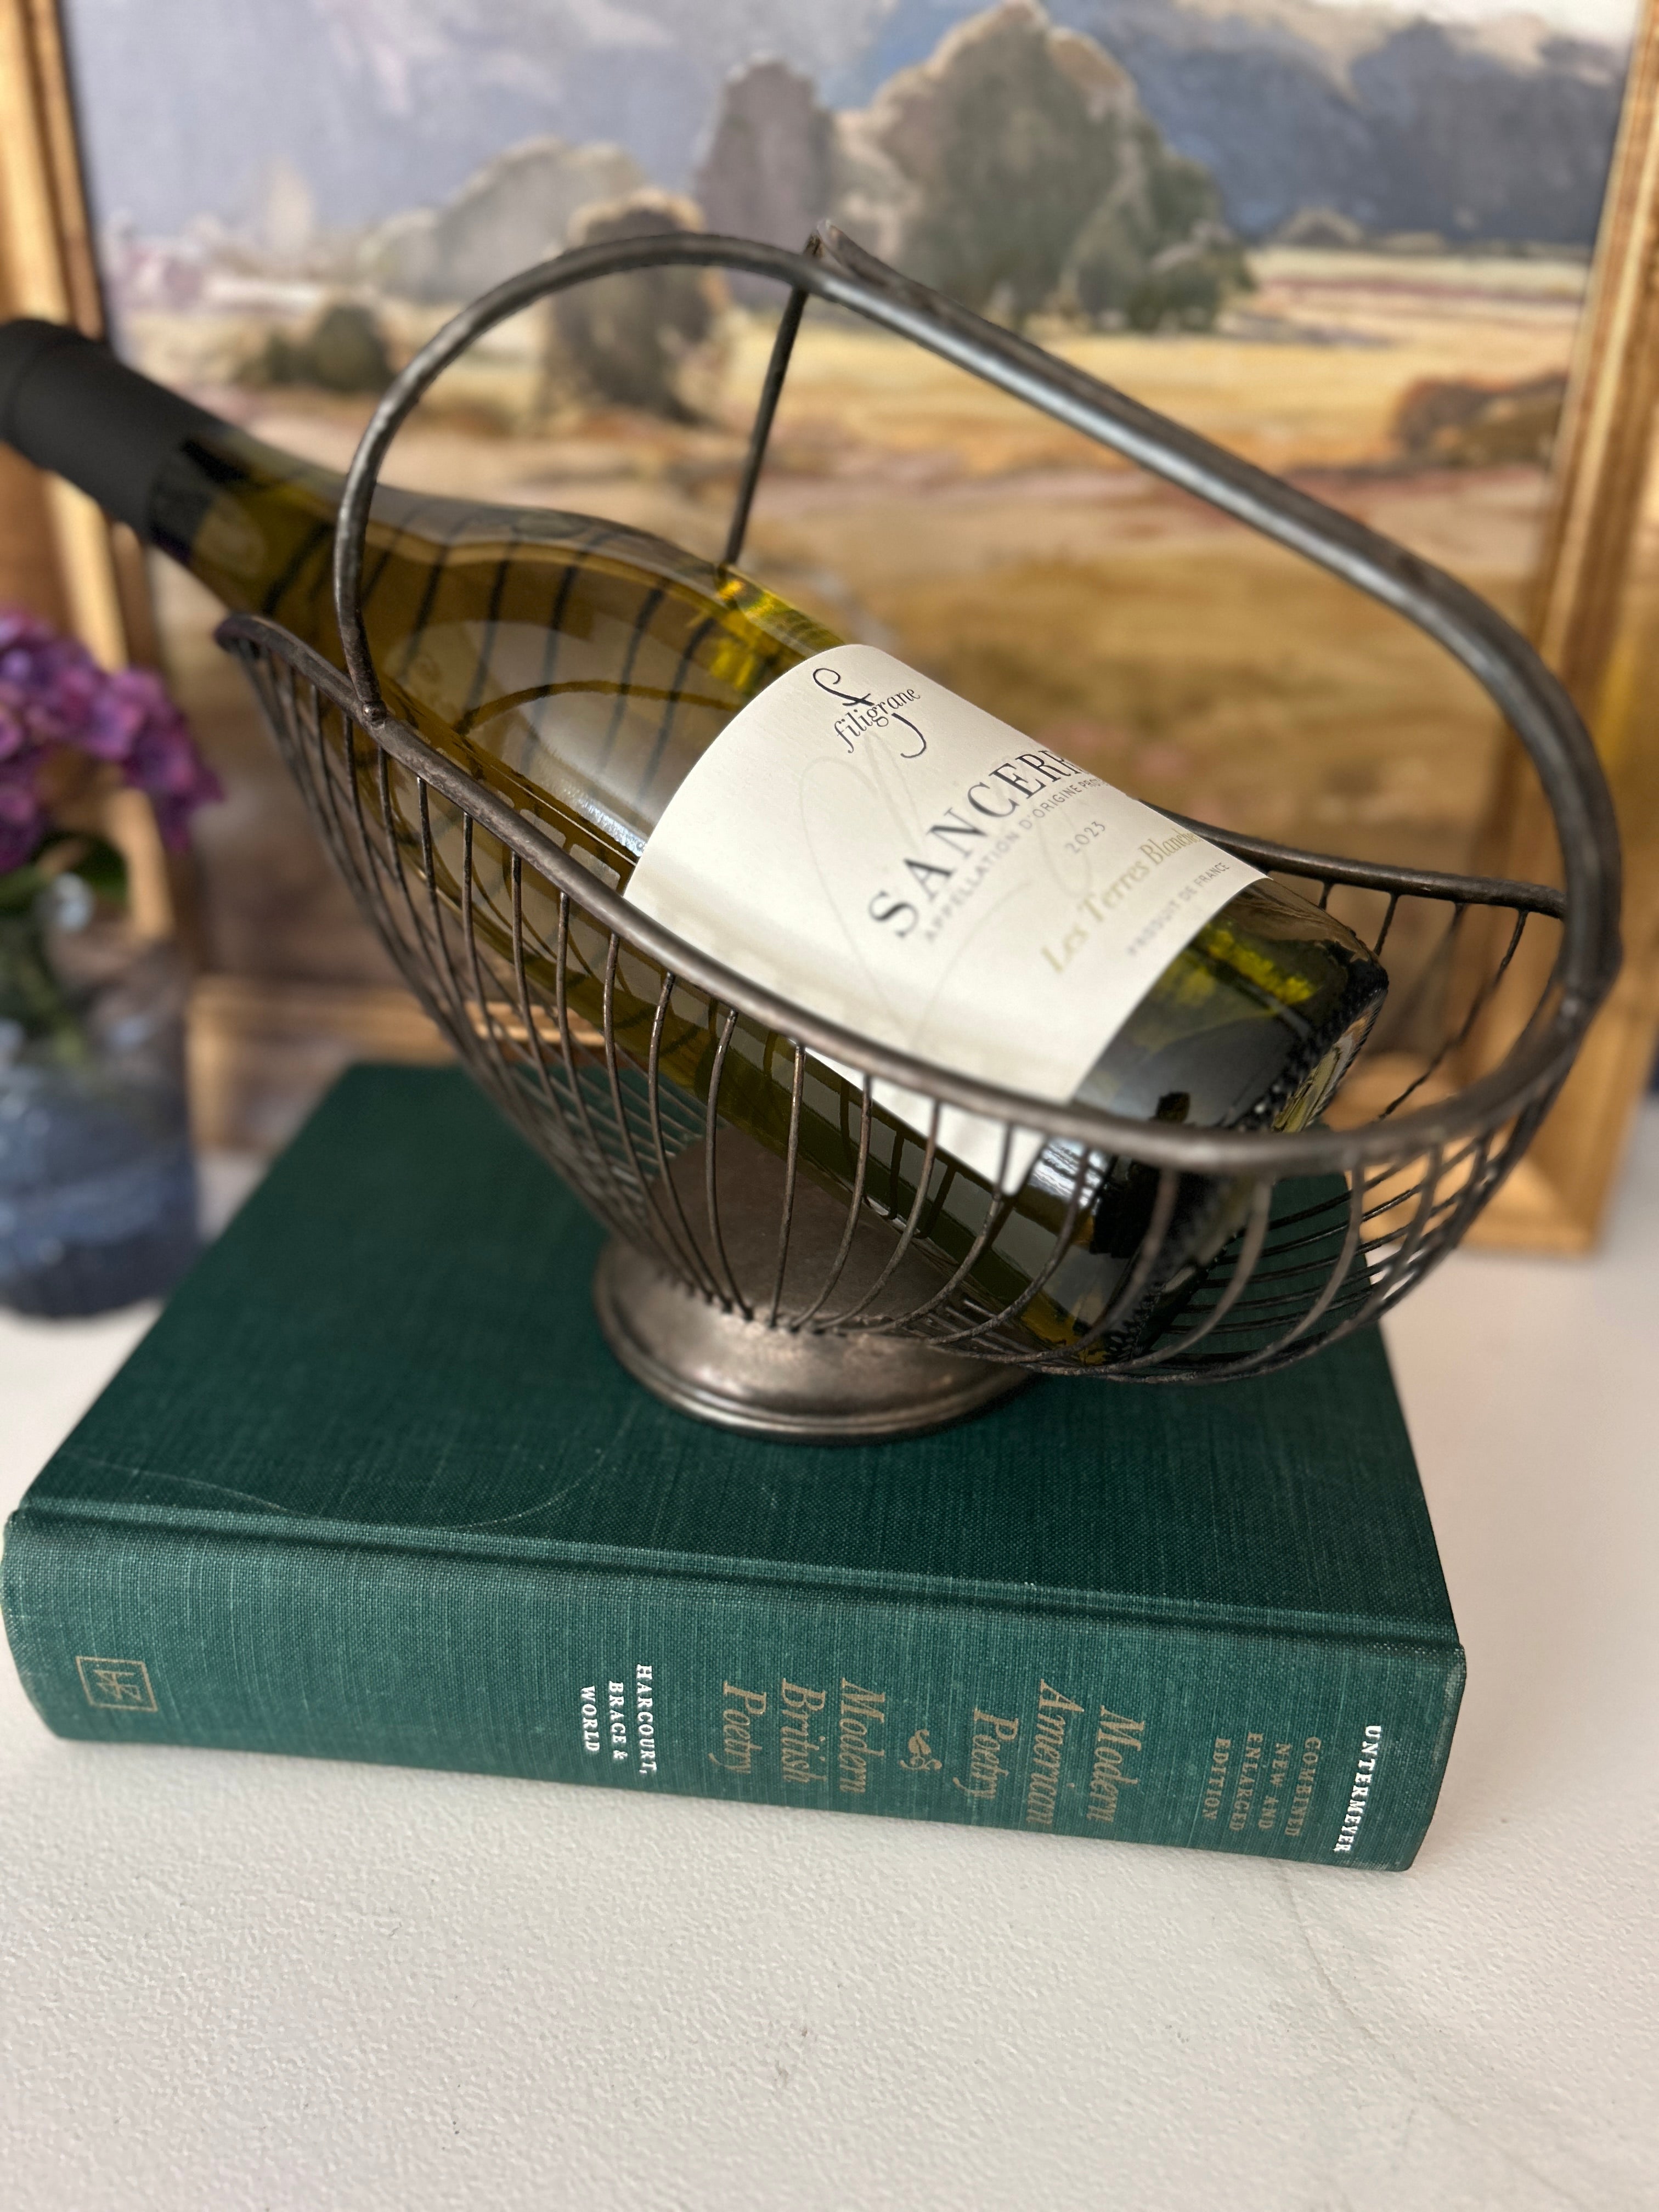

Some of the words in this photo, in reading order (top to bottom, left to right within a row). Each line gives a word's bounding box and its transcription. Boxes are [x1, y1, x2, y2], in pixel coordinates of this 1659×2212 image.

[834, 689, 921, 754] filigrane
[868, 750, 1088, 938] SANCERR
[924, 831, 1019, 942] APPELLATION
[1019, 785, 1082, 830] D'ORIGINE
[1065, 821, 1105, 854] 2023
[1177, 885, 1198, 903] DE
[1193, 862, 1230, 888] FRANCE
[1040, 922, 1089, 973] Les
[1077, 860, 1151, 922] Terres
[1137, 828, 1204, 865] Blanche
[580, 1685, 600, 1752] WORLD
[608, 1680, 628, 1745] BRACE
[613, 1749, 629, 1760] &
[636, 1663, 657, 1775] HARCOURT,
[708, 1680, 768, 1774] Poetry
[781, 1677, 828, 1784] British
[839, 1677, 885, 1793] Modern
[952, 1707, 1019, 1800] Poetry
[1026, 1678, 1085, 1825] American
[1086, 1705, 1146, 1823] Modern
[1203, 1737, 1232, 1820] EDITION
[1228, 1731, 1264, 1832] ENLARGED
[1271, 1742, 1293, 1788] NEW
[1284, 1736, 1322, 1837] COMBINED
[1333, 1725, 1382, 1853] UNTERMEYER
[1258, 1796, 1279, 1831] AND
